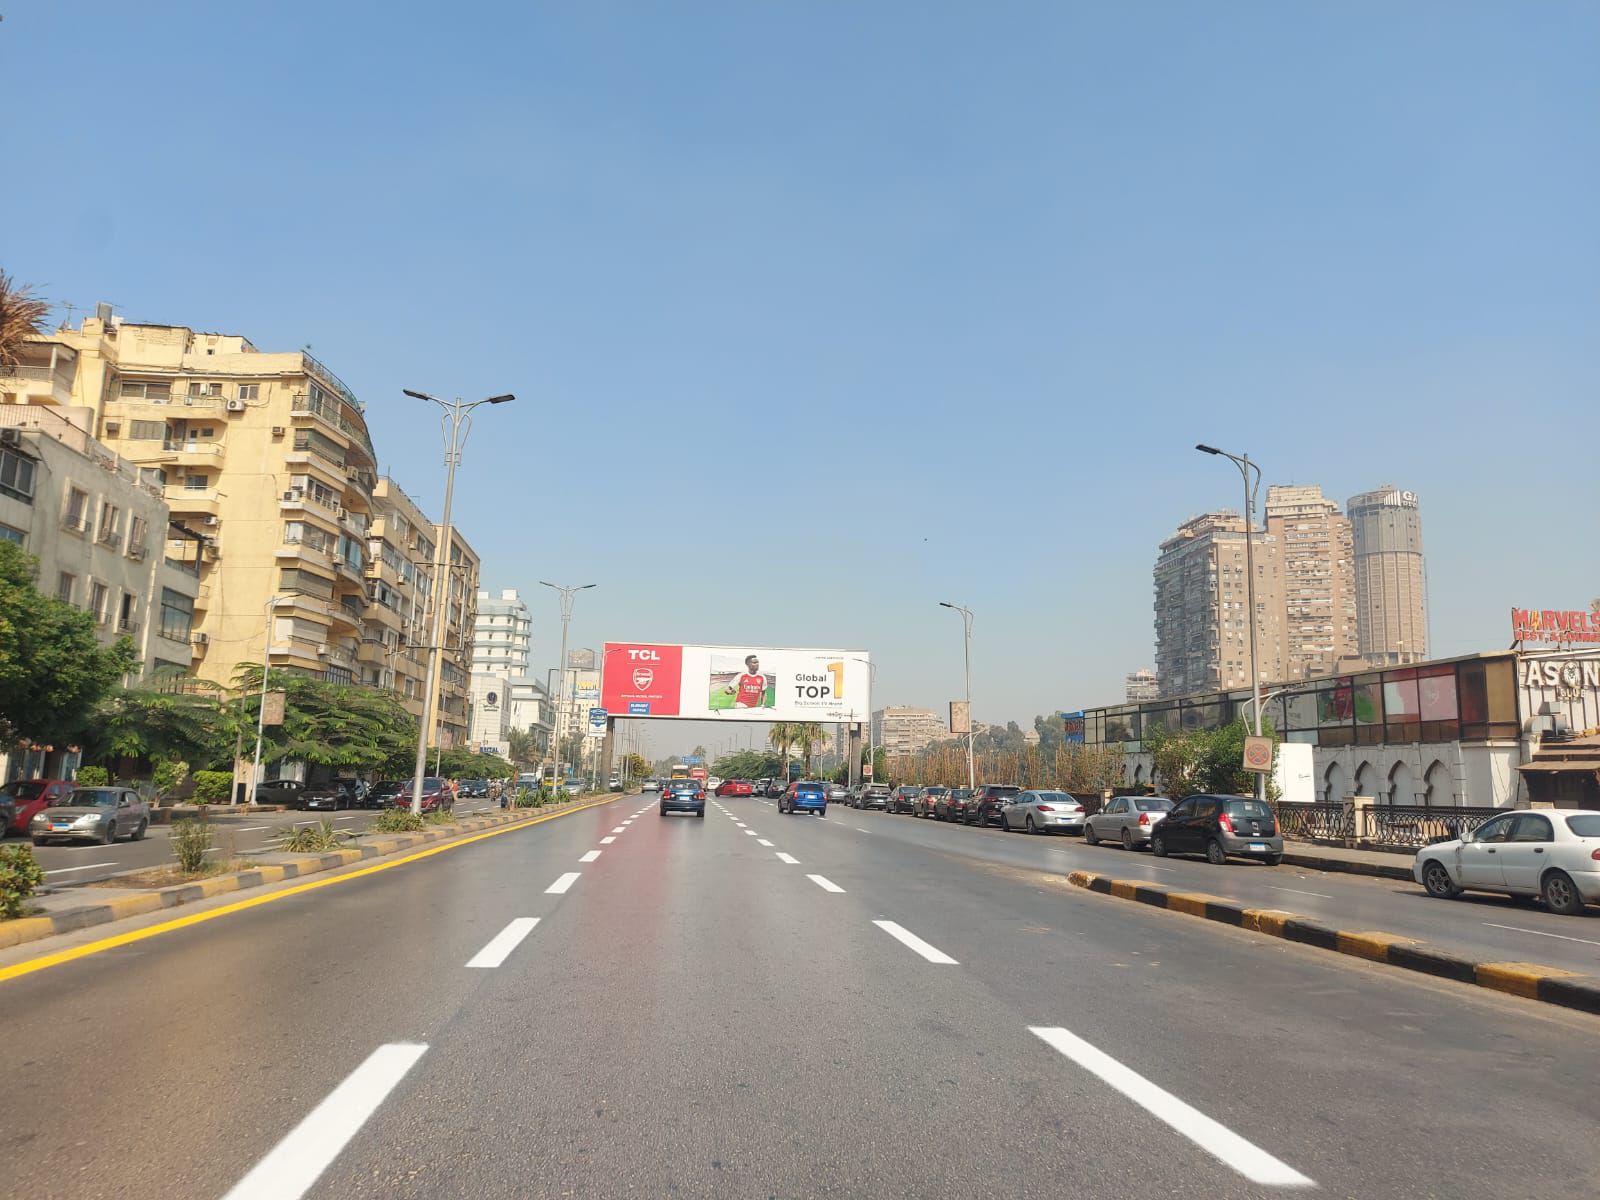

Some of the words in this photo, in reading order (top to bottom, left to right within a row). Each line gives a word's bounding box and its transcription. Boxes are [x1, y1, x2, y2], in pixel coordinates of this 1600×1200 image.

[1512, 608, 1600, 632] MARVELS
[628, 649, 660, 661] TCL
[795, 673, 827, 682] Global
[827, 661, 844, 699] 1
[795, 685, 830, 699] TOP
